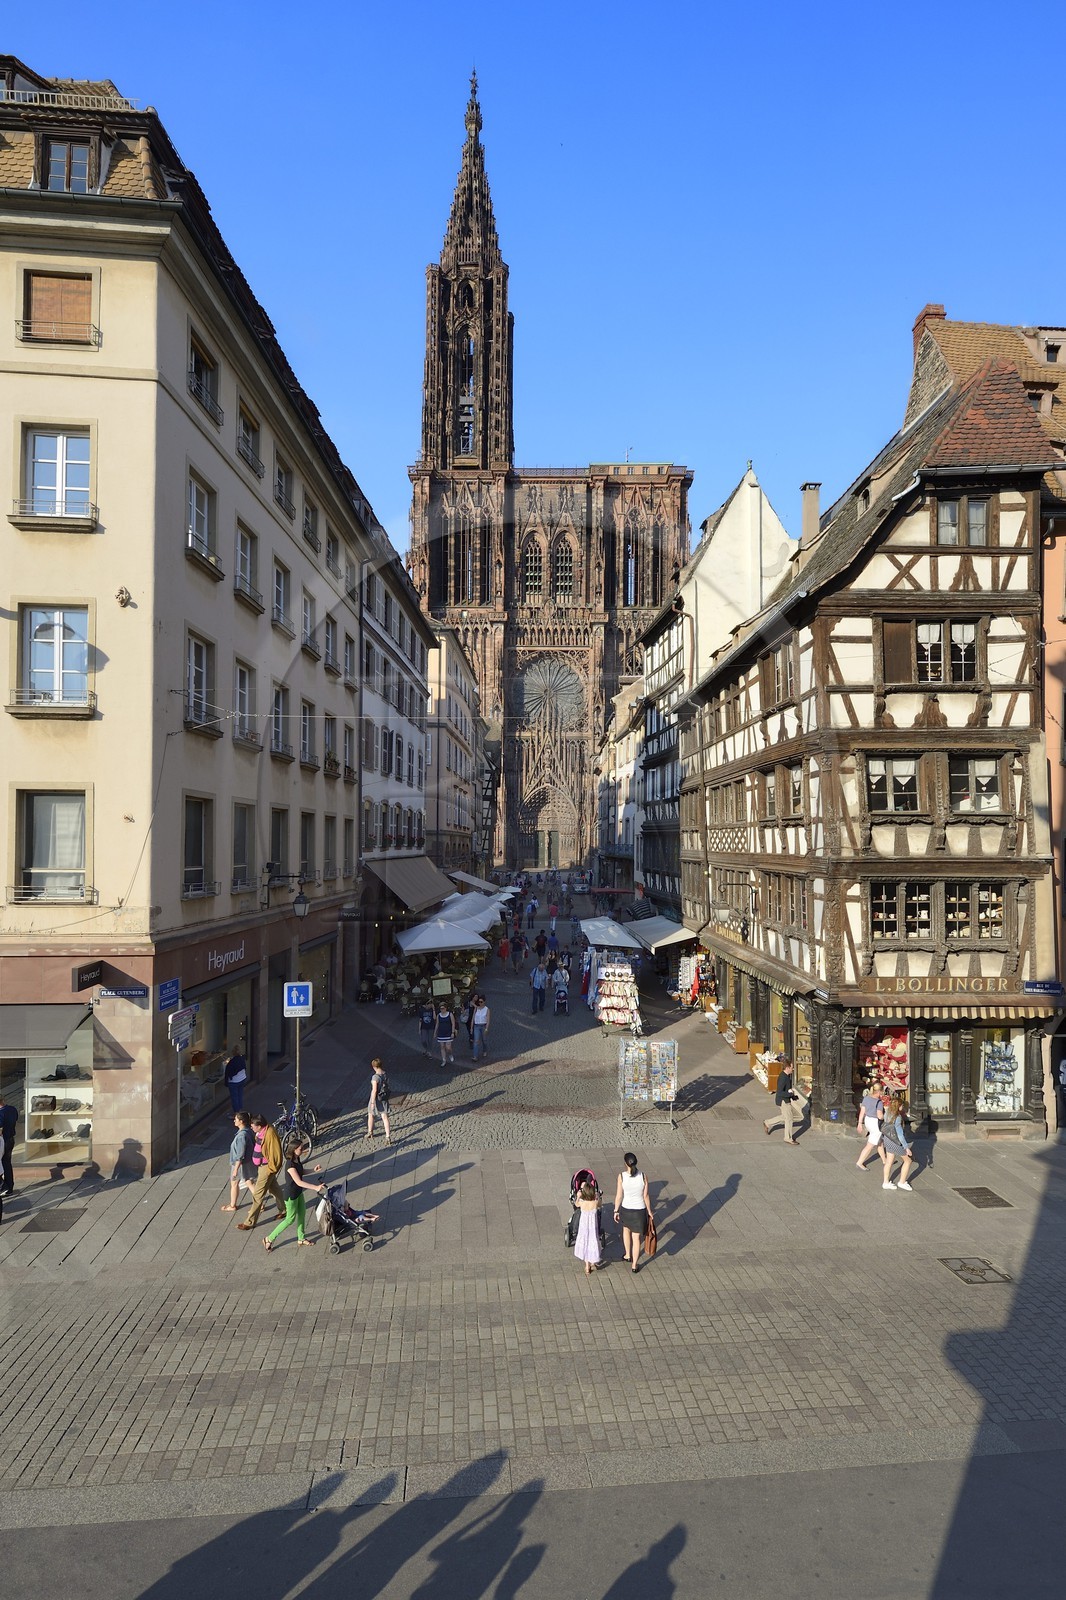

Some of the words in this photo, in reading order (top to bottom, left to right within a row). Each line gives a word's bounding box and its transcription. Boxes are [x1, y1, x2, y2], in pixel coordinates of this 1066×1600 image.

[208, 940, 245, 973] Heyraud
[80, 967, 101, 983] Heyraud
[876, 979, 891, 992] L.
[895, 978, 1008, 992] BOLLINGER
